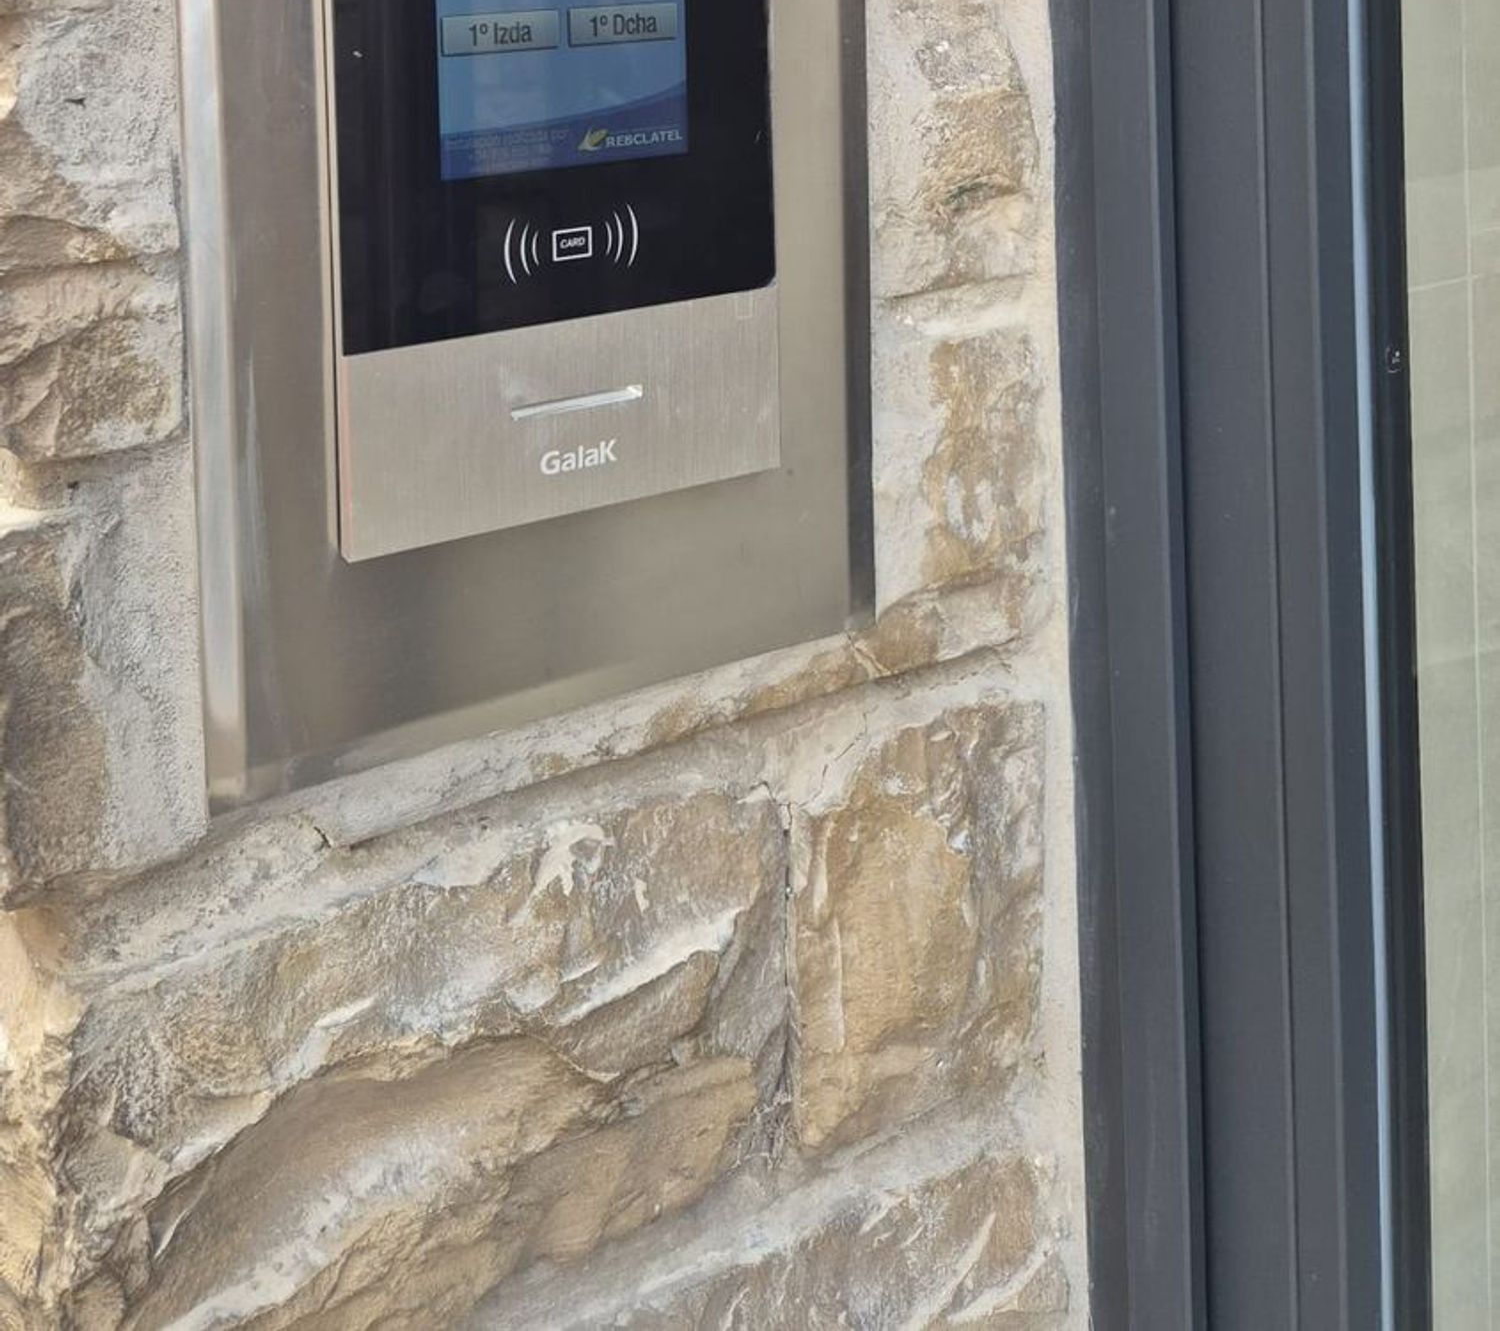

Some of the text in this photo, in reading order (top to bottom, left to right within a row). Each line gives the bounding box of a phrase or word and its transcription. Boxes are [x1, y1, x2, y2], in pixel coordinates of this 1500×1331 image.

[468, 23, 532, 46] 1º Izda
[589, 13, 658, 38] 1º Dcha
[559, 236, 586, 249] CARD
[540, 438, 618, 475] GalaK
